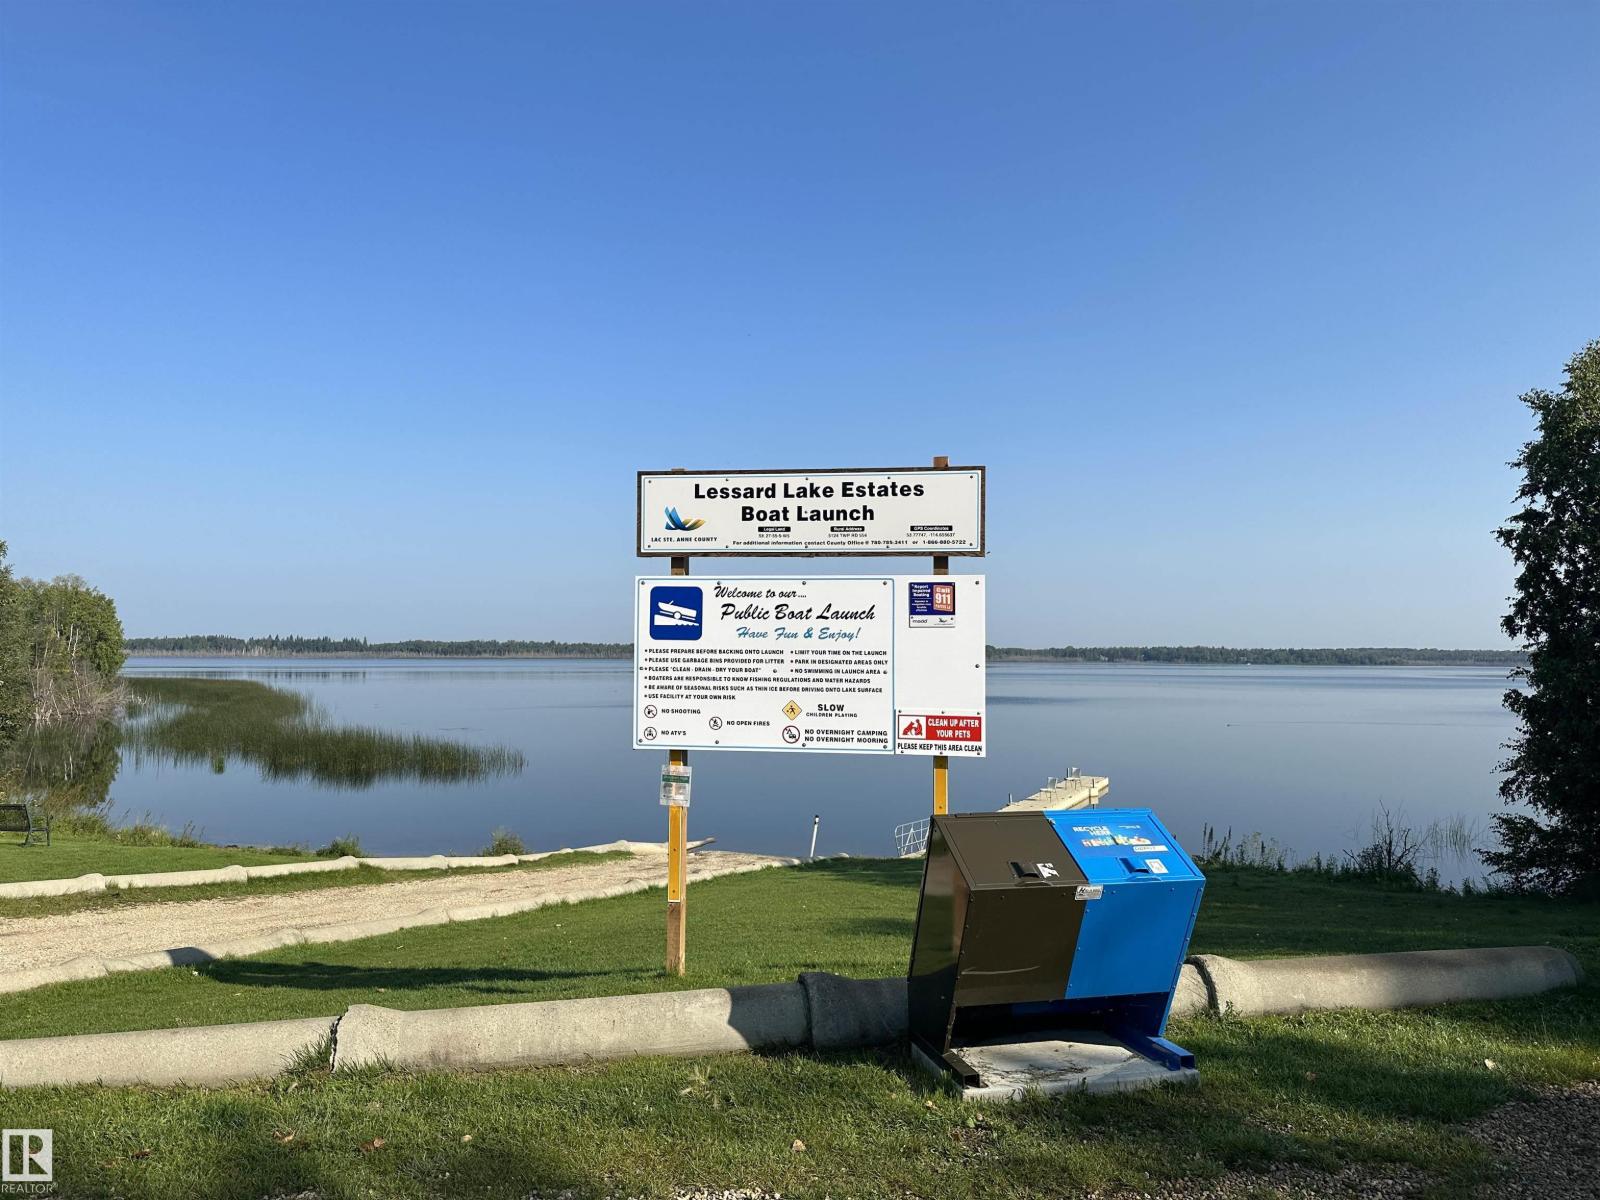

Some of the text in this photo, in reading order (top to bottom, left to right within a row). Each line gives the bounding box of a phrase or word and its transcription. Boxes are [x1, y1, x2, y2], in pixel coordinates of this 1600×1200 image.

[694, 482, 925, 499] Lessard Lake Estates
[741, 505, 875, 521] Boat Launch
[713, 586, 762, 598] Welcome
[766, 589, 776, 598] to
[936, 593, 951, 604] 911
[720, 603, 876, 620] Public Boat Launch
[736, 627, 861, 642] Have Fun & Enjoy!
[955, 730, 970, 738] PETS
